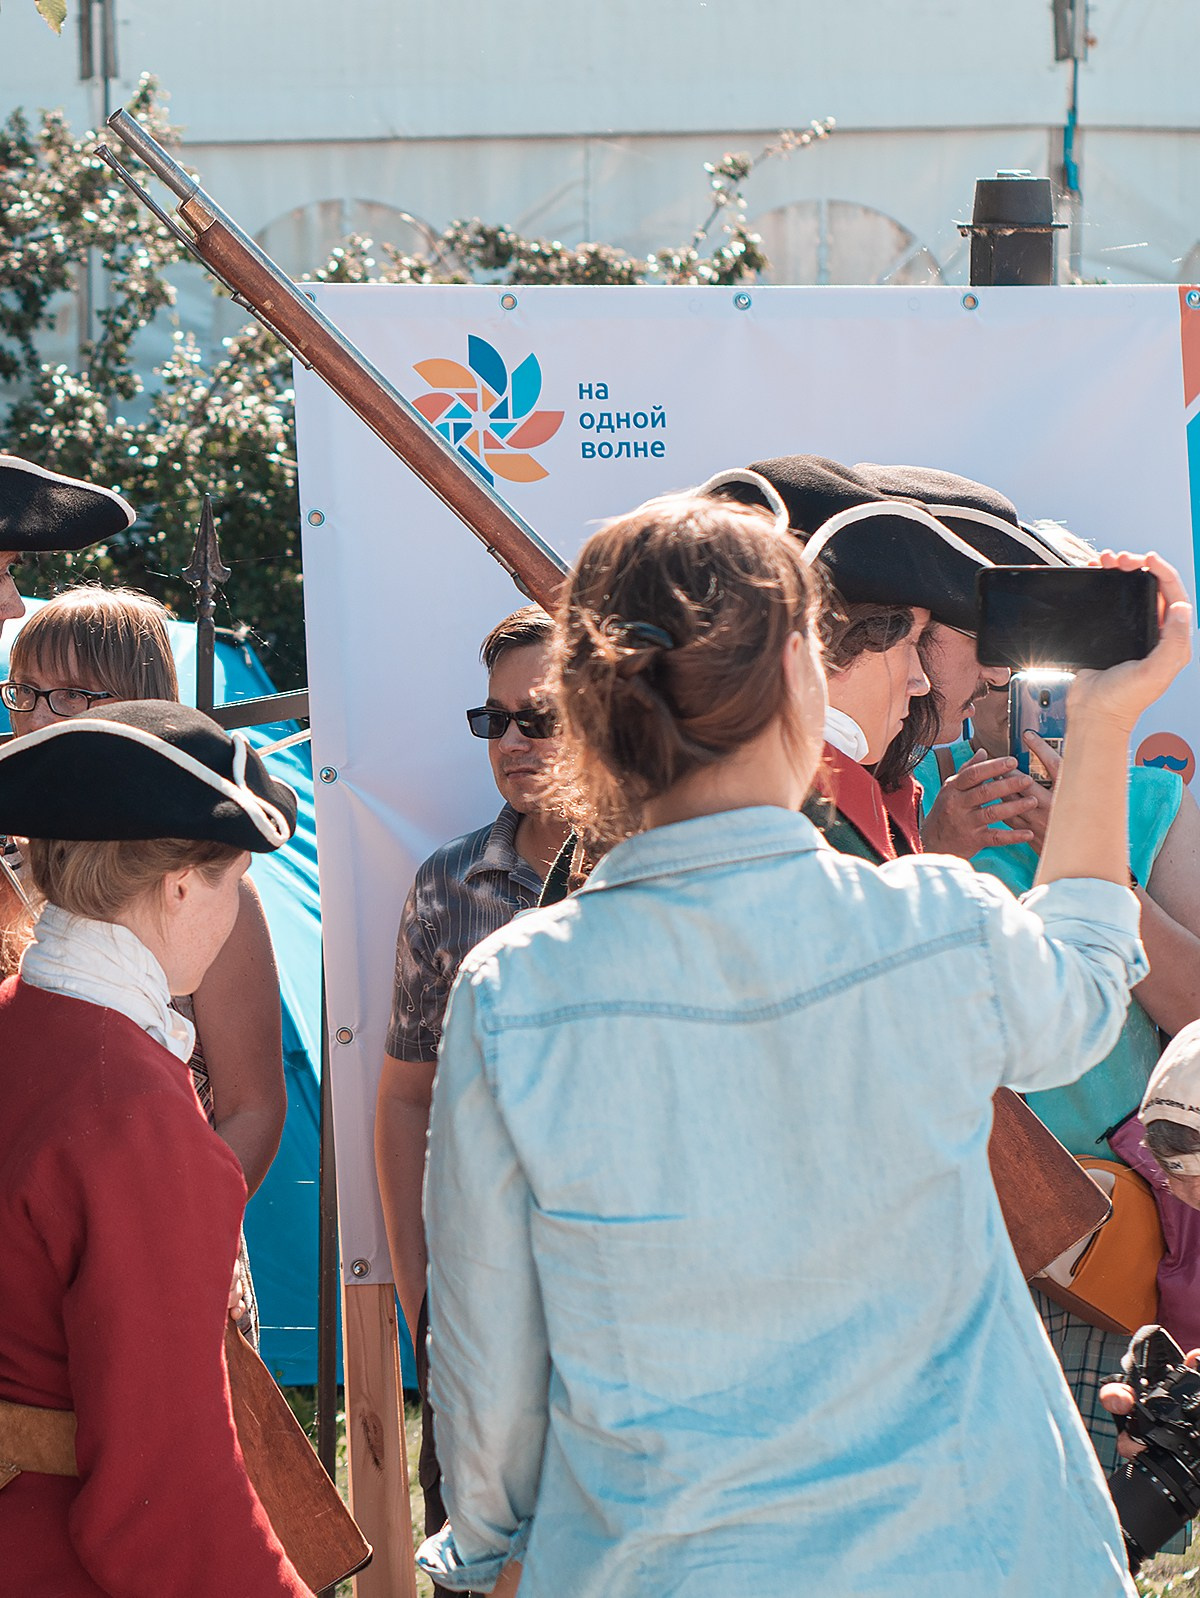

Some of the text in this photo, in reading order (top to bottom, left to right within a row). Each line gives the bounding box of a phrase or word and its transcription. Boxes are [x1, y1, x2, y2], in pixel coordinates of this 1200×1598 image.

[578, 382, 609, 400] на
[579, 405, 667, 434] одной
[581, 440, 666, 459] волне
